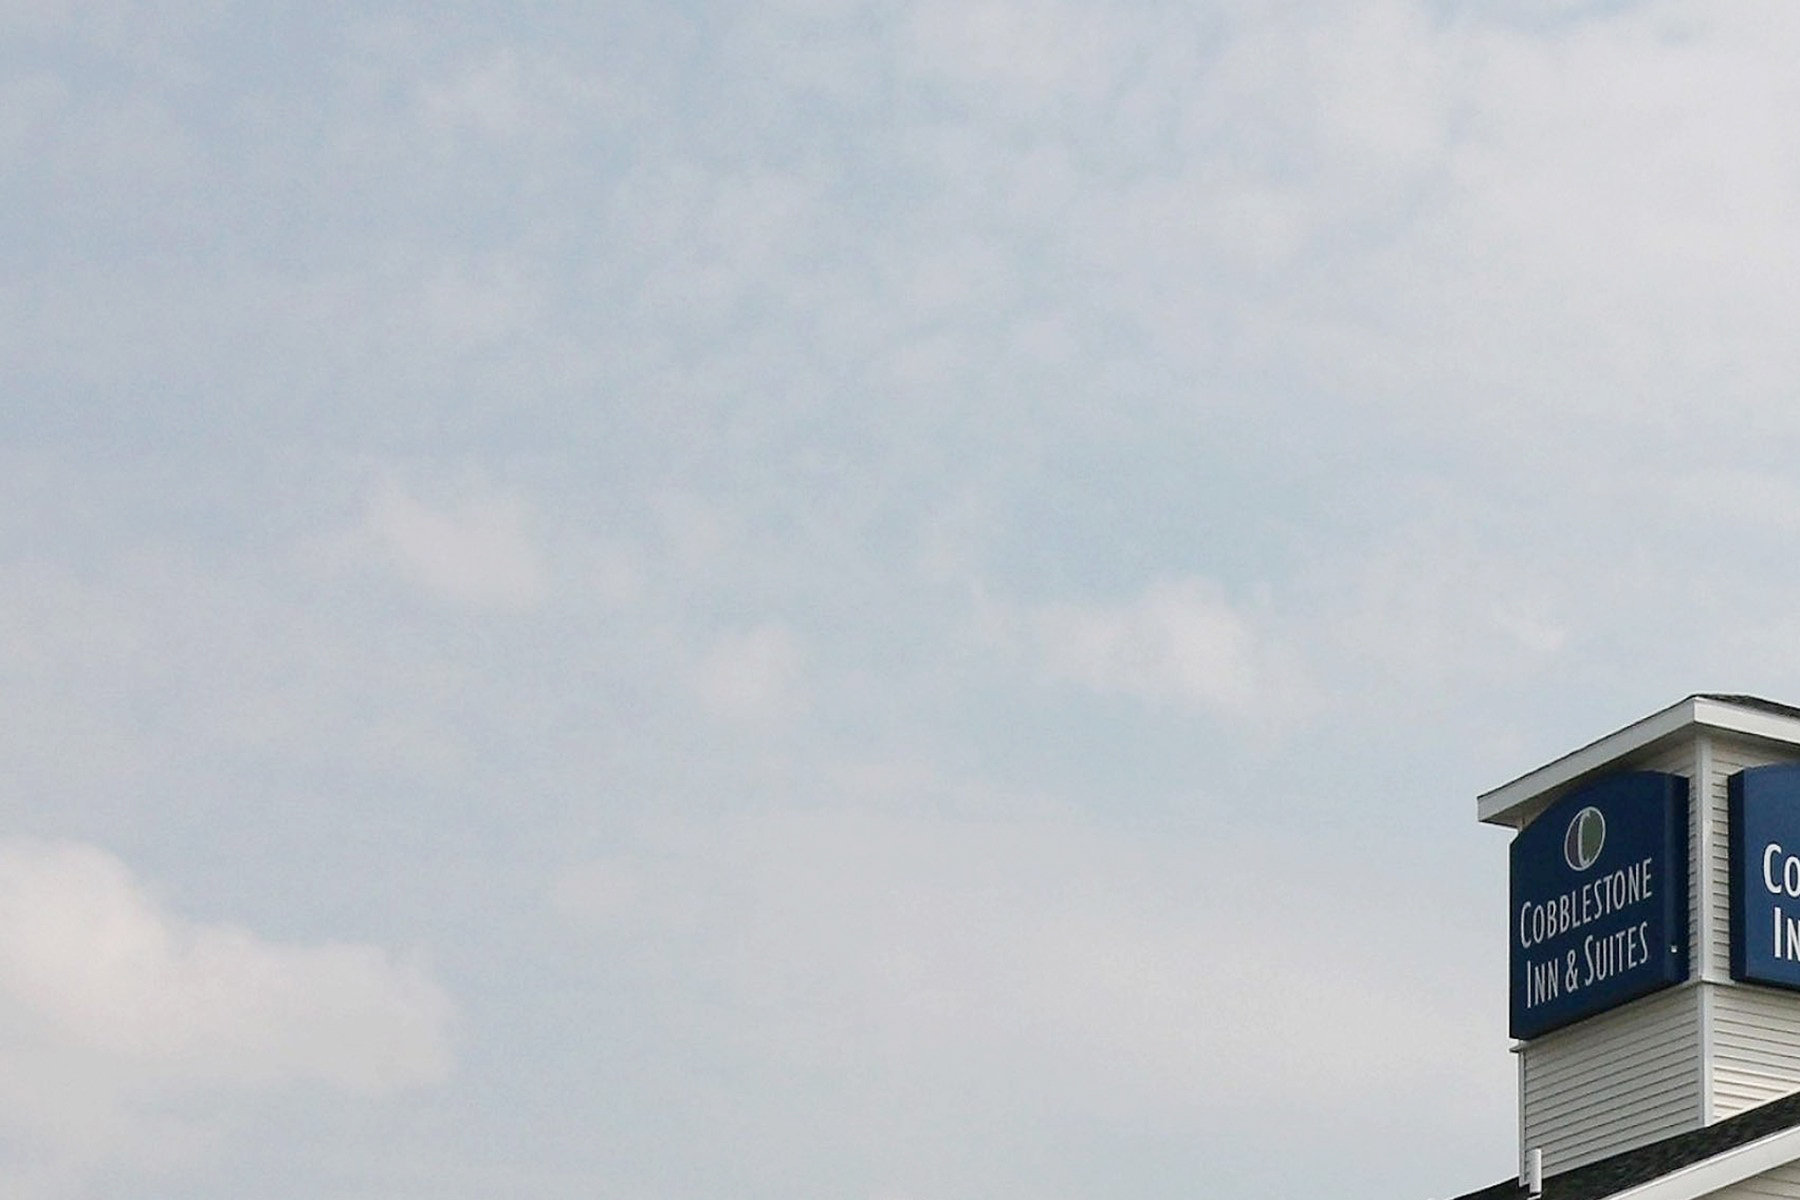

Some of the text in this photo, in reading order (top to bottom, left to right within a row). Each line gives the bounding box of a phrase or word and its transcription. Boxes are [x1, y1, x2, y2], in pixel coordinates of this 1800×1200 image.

[1520, 857, 1652, 949] COBBLESTONE
[1526, 921, 1648, 1009] INN & SUITES
